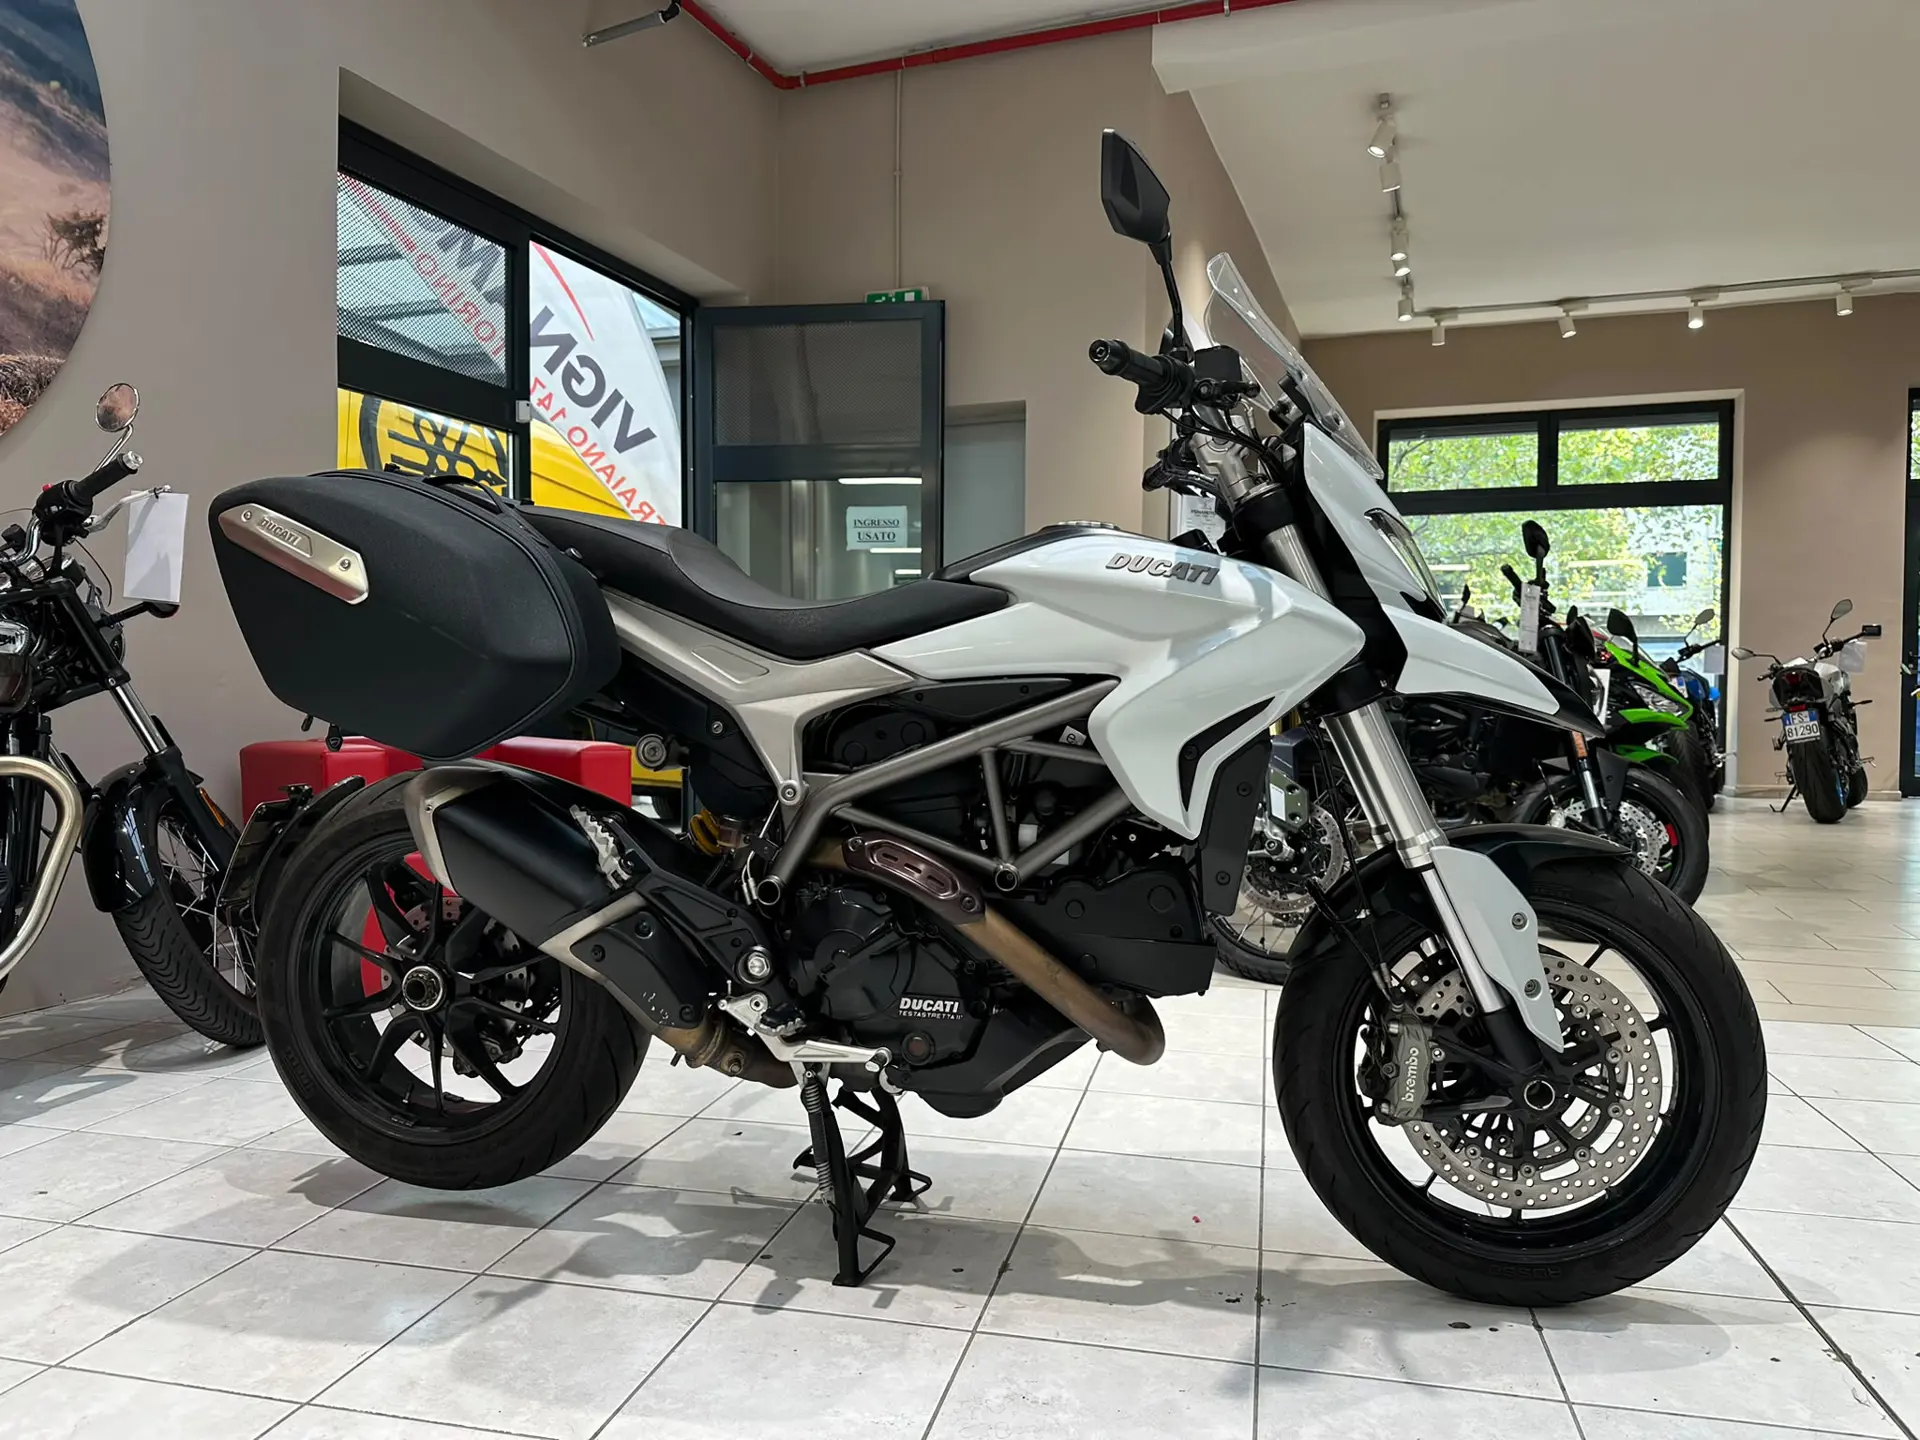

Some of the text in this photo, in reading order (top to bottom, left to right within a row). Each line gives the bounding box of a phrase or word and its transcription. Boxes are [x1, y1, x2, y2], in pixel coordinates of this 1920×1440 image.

[854, 519, 900, 528] INGRESSO
[260, 517, 302, 546] DUCATI
[857, 531, 896, 541] USATO
[1105, 552, 1220, 585] DUCATI
[1787, 723, 1818, 737] 81290
[899, 997, 959, 1013] DUCATI
[898, 1010, 955, 1019] TESTASTRETTA
[1401, 1047, 1419, 1102] brembo
